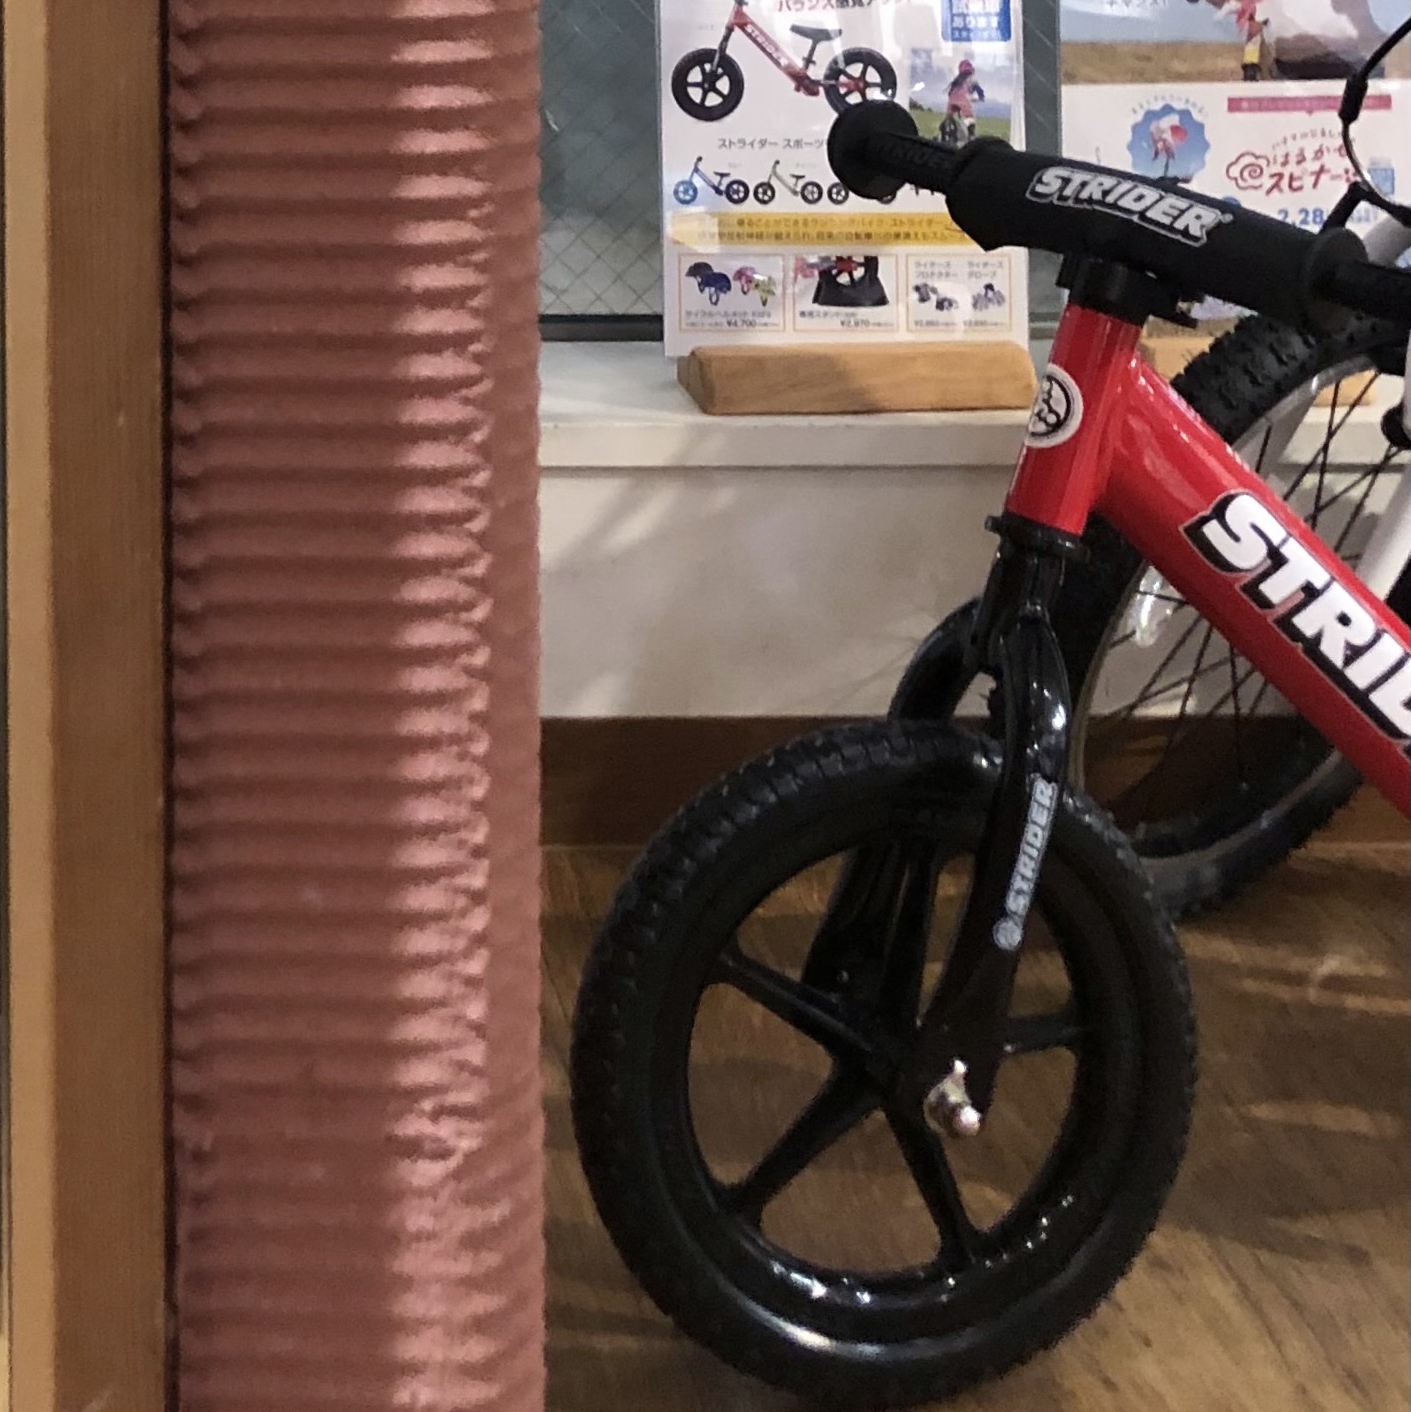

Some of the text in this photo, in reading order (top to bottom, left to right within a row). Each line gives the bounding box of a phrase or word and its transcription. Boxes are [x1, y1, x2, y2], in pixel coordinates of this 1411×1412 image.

[718, 137, 778, 149] ストライダー
[1030, 167, 1225, 244] STRIDER
[1005, 779, 1058, 920] STRIDER
